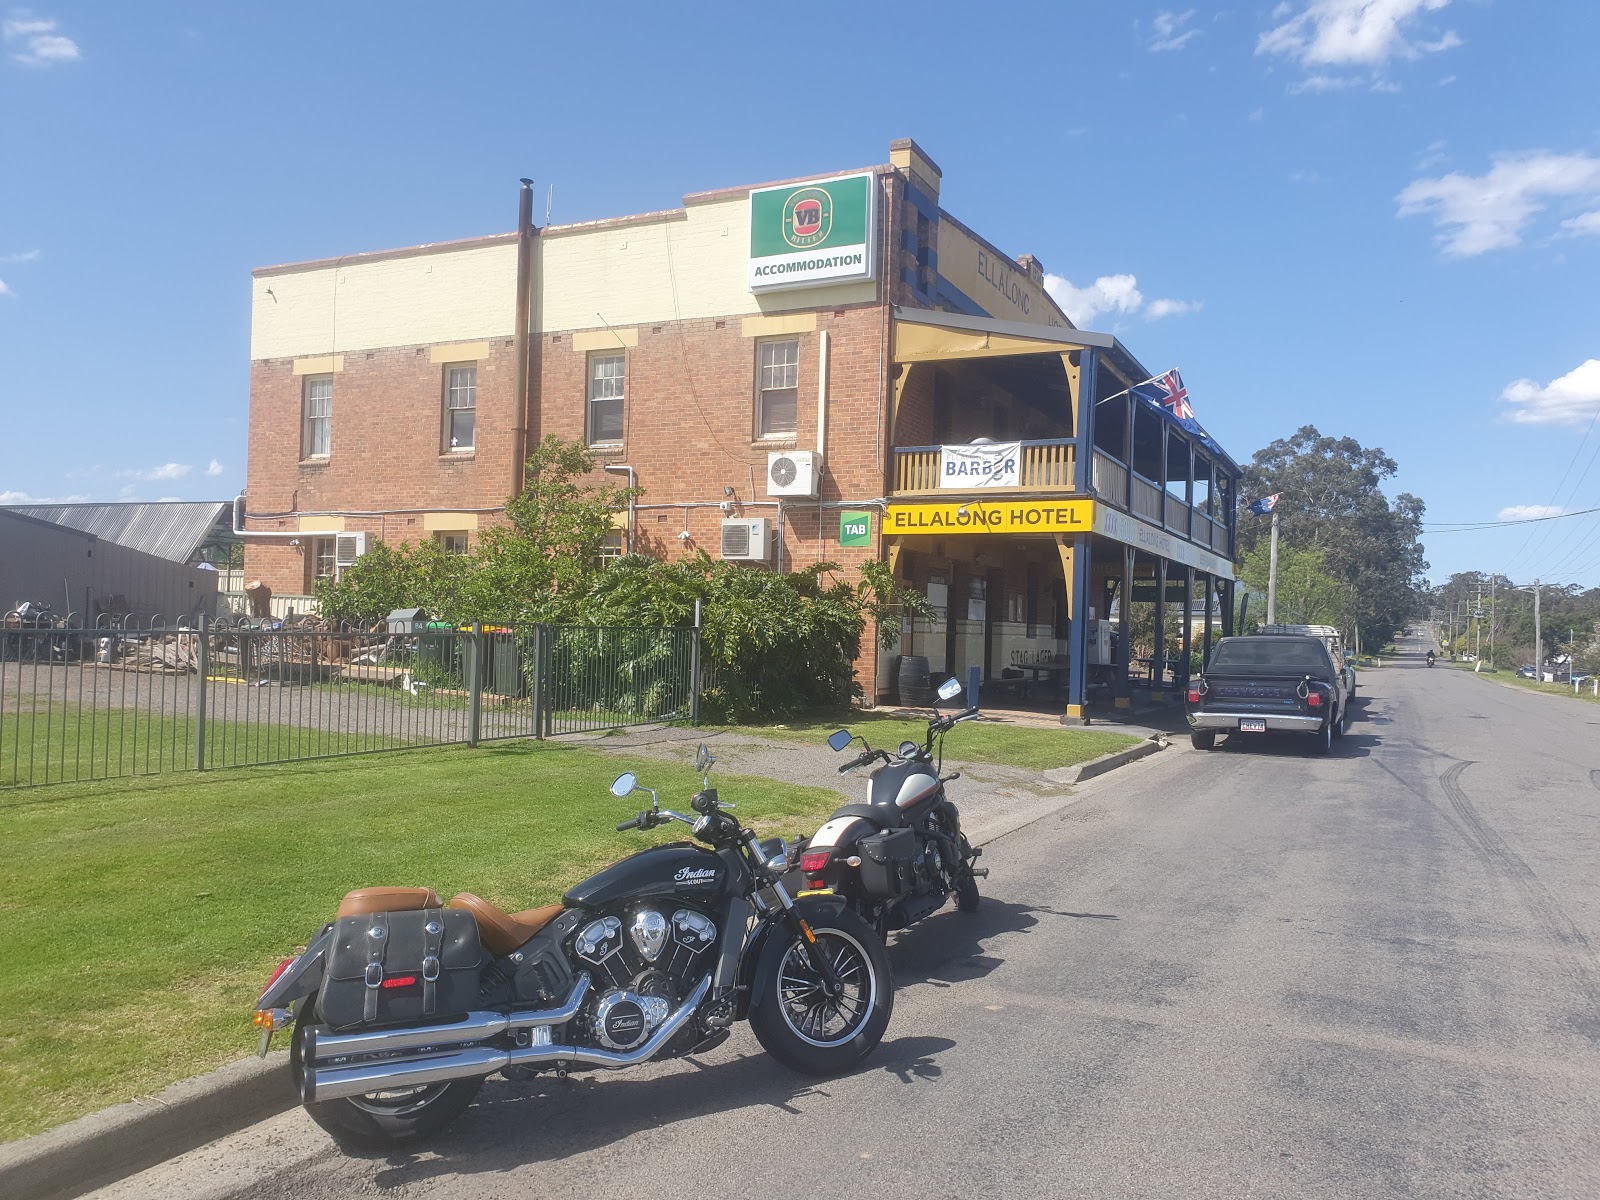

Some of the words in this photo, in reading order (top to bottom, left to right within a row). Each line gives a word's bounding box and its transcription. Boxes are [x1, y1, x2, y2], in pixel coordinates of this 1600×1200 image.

[794, 208, 821, 227] VB
[791, 230, 824, 244] BITTER
[754, 254, 862, 277] ACCOMMODATION
[895, 510, 1002, 527] ELLALONG
[1010, 508, 1081, 525] HOTEL
[844, 524, 866, 535] TAB
[414, 622, 424, 630] 84
[1010, 650, 1028, 664] STAG
[1217, 687, 1289, 697] CHEVROLET
[673, 866, 716, 881] Indian
[612, 1019, 639, 1029] Indian
